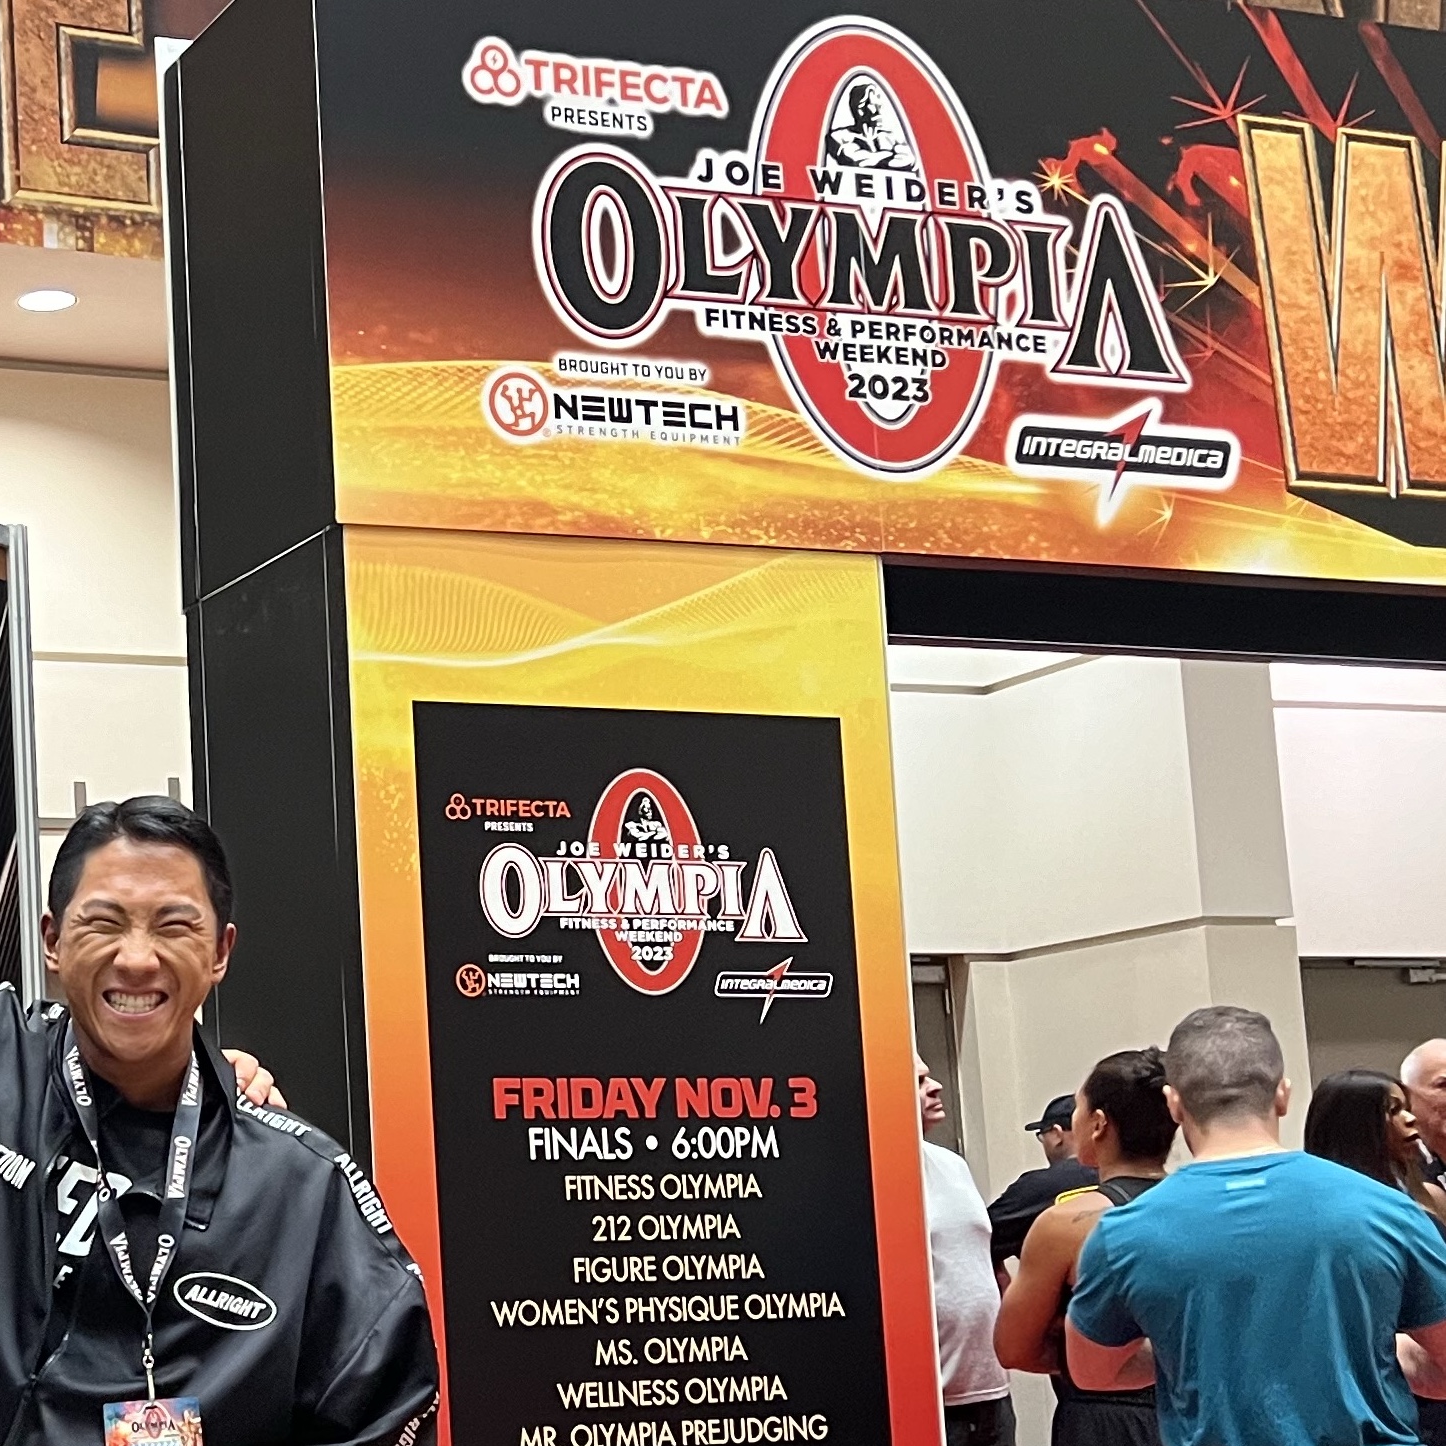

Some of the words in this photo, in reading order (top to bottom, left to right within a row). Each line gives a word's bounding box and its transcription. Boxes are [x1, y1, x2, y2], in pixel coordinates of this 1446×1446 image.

[524, 58, 723, 111] TRIFECTA
[551, 106, 648, 131] PRESENTS
[697, 157, 783, 190] JOE
[810, 167, 1034, 214] WEIDER'S
[542, 151, 1189, 384] OLYMPIA
[706, 308, 817, 335] FITNESS
[826, 318, 842, 337] &
[850, 320, 1047, 353] PERFORMANCE
[814, 340, 947, 368] WEEKEND
[558, 358, 628, 377] BROUGHT
[632, 363, 650, 377] TO
[657, 365, 684, 380] YOU
[689, 368, 706, 381] BY
[847, 373, 930, 402] 2023
[553, 393, 739, 432] NEWTECH
[556, 424, 640, 439] STRENGTH
[650, 430, 741, 446] EQUIPMENT
[472, 798, 571, 818] TRIFECTA
[484, 821, 534, 832] PRESENTS
[556, 840, 600, 857] JOE
[613, 843, 730, 860] WEIDER'S
[479, 842, 808, 943] OLYMPIA
[559, 917, 617, 930] FITNESS
[620, 919, 630, 930] &
[633, 919, 735, 932] PERFORMANCE
[615, 931, 683, 943] WEEKEND
[631, 946, 674, 961] 2023
[487, 973, 580, 988] NEWTECH
[65, 1046, 92, 1106] OLYMPIA
[236, 1088, 312, 1137] LLRIGHT
[492, 1076, 667, 1121] FRIDAY
[675, 1077, 779, 1119] NOV.
[788, 1076, 818, 1118] 3
[529, 1127, 633, 1160] FINALS
[672, 1126, 779, 1159] 6:00PM
[167, 1136, 191, 1199] OLYMPIA
[334, 1153, 393, 1235] ALLRIGHT
[565, 1174, 654, 1200] FITNESS
[660, 1174, 762, 1199] OLYMPIA
[592, 1216, 632, 1241] 212
[638, 1214, 741, 1240] OLYMPIA
[574, 1256, 657, 1283] FIGURE
[663, 1254, 765, 1281] OLYMPIA
[184, 1284, 266, 1319] ALLRIGHT
[491, 1298, 619, 1327] WOMEN'S
[625, 1295, 739, 1323] PHYSIQUE
[745, 1292, 845, 1319] OLYMPIA
[596, 1339, 638, 1365] MS.
[644, 1336, 748, 1364] OLYMPIA
[557, 1379, 679, 1409] WELLNESS
[685, 1375, 787, 1404] OLYMPIA
[682, 1414, 828, 1445] PREJUDGING
